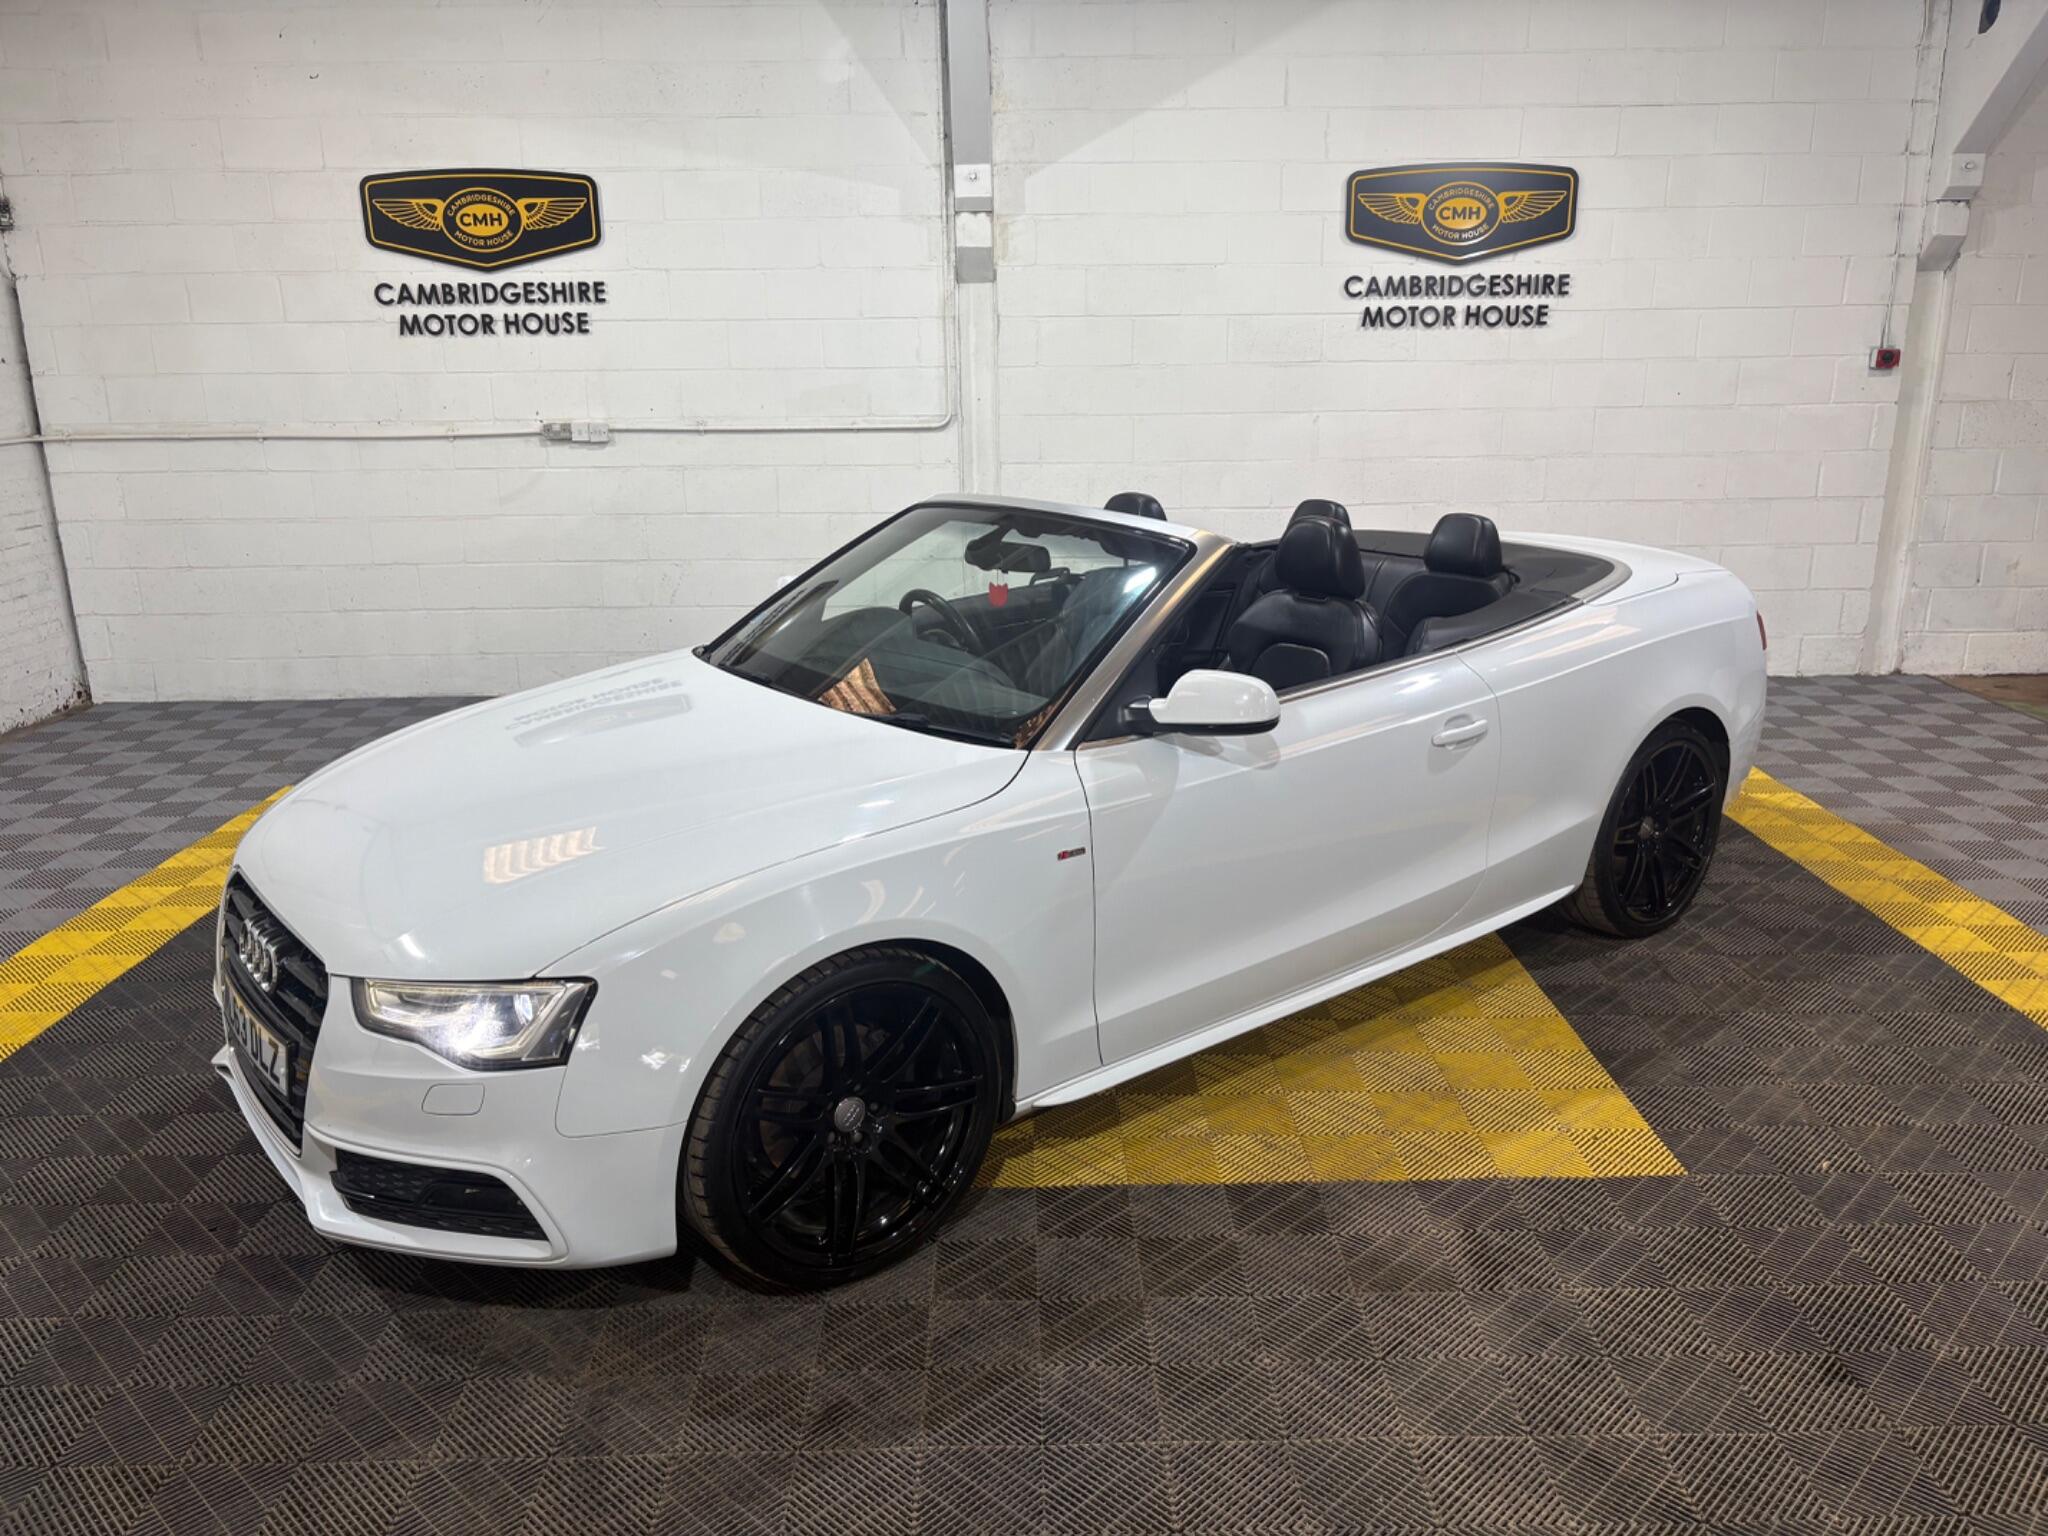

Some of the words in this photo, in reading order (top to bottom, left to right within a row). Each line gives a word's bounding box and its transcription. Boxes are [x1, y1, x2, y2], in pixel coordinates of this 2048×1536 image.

[447, 194, 516, 217] CAMBRIDGESHIRE
[1427, 187, 1495, 210] CAMBRIDGESHIRE
[459, 212, 503, 227] CMH
[1438, 206, 1481, 220] CMH
[454, 230, 485, 246] MOTOR
[486, 230, 514, 246] HOUSE
[1432, 224, 1460, 240] MOTOR
[1461, 224, 1489, 239] HOUSE
[374, 281, 606, 306] CAMBRIDGESHIRE
[1344, 274, 1571, 299] CAMBRIDGESHIRE
[399, 314, 495, 336] MOTOR
[504, 312, 590, 334] HOUSE
[1361, 306, 1456, 328] MOTOR
[1464, 304, 1549, 326] HOUSE
[250, 1017, 281, 1085] DLZ
